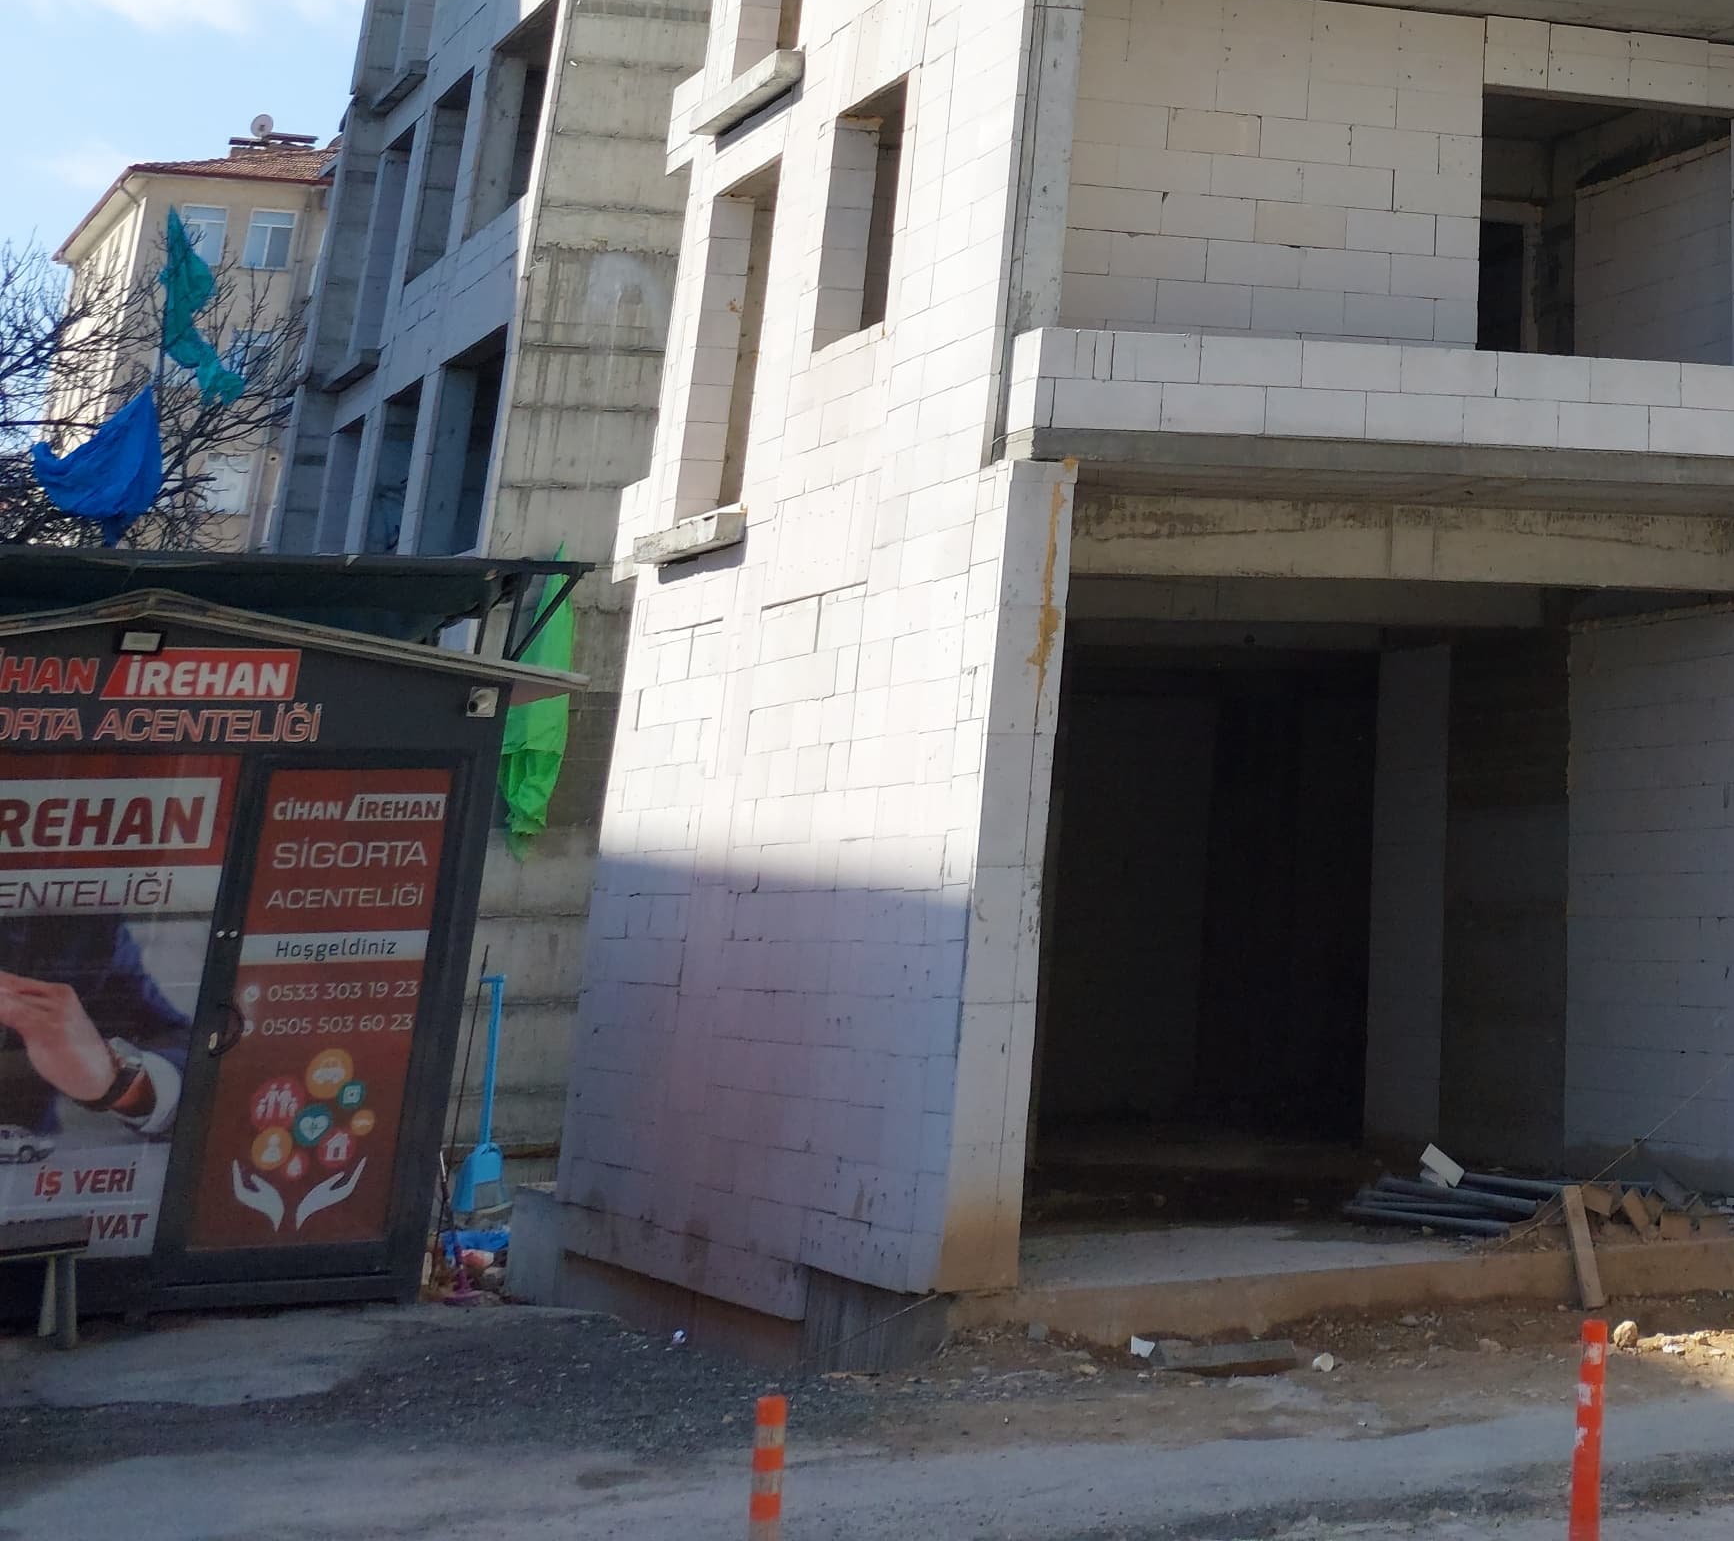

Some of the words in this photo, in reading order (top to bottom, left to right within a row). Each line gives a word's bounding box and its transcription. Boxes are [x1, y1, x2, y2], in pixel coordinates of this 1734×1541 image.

[0, 648, 99, 694] HAN
[124, 654, 290, 696] İREHAN
[93, 703, 322, 742] ACENTELİĞİ
[273, 797, 341, 820] CİHAN
[357, 797, 441, 819] İREHAN
[273, 837, 427, 869] SİGORTA
[265, 883, 425, 909] ACENTELİĞİ
[275, 938, 397, 962] Hoşgeldiniz
[267, 982, 317, 1002] 0533
[323, 981, 362, 1000] 303
[368, 981, 389, 998] 19
[393, 980, 418, 998] 23
[261, 1018, 311, 1036] 0505
[317, 1017, 353, 1034] 503
[390, 1014, 414, 1031] 23
[34, 1164, 63, 1202] İŞ
[73, 1161, 136, 1194] YERİ
